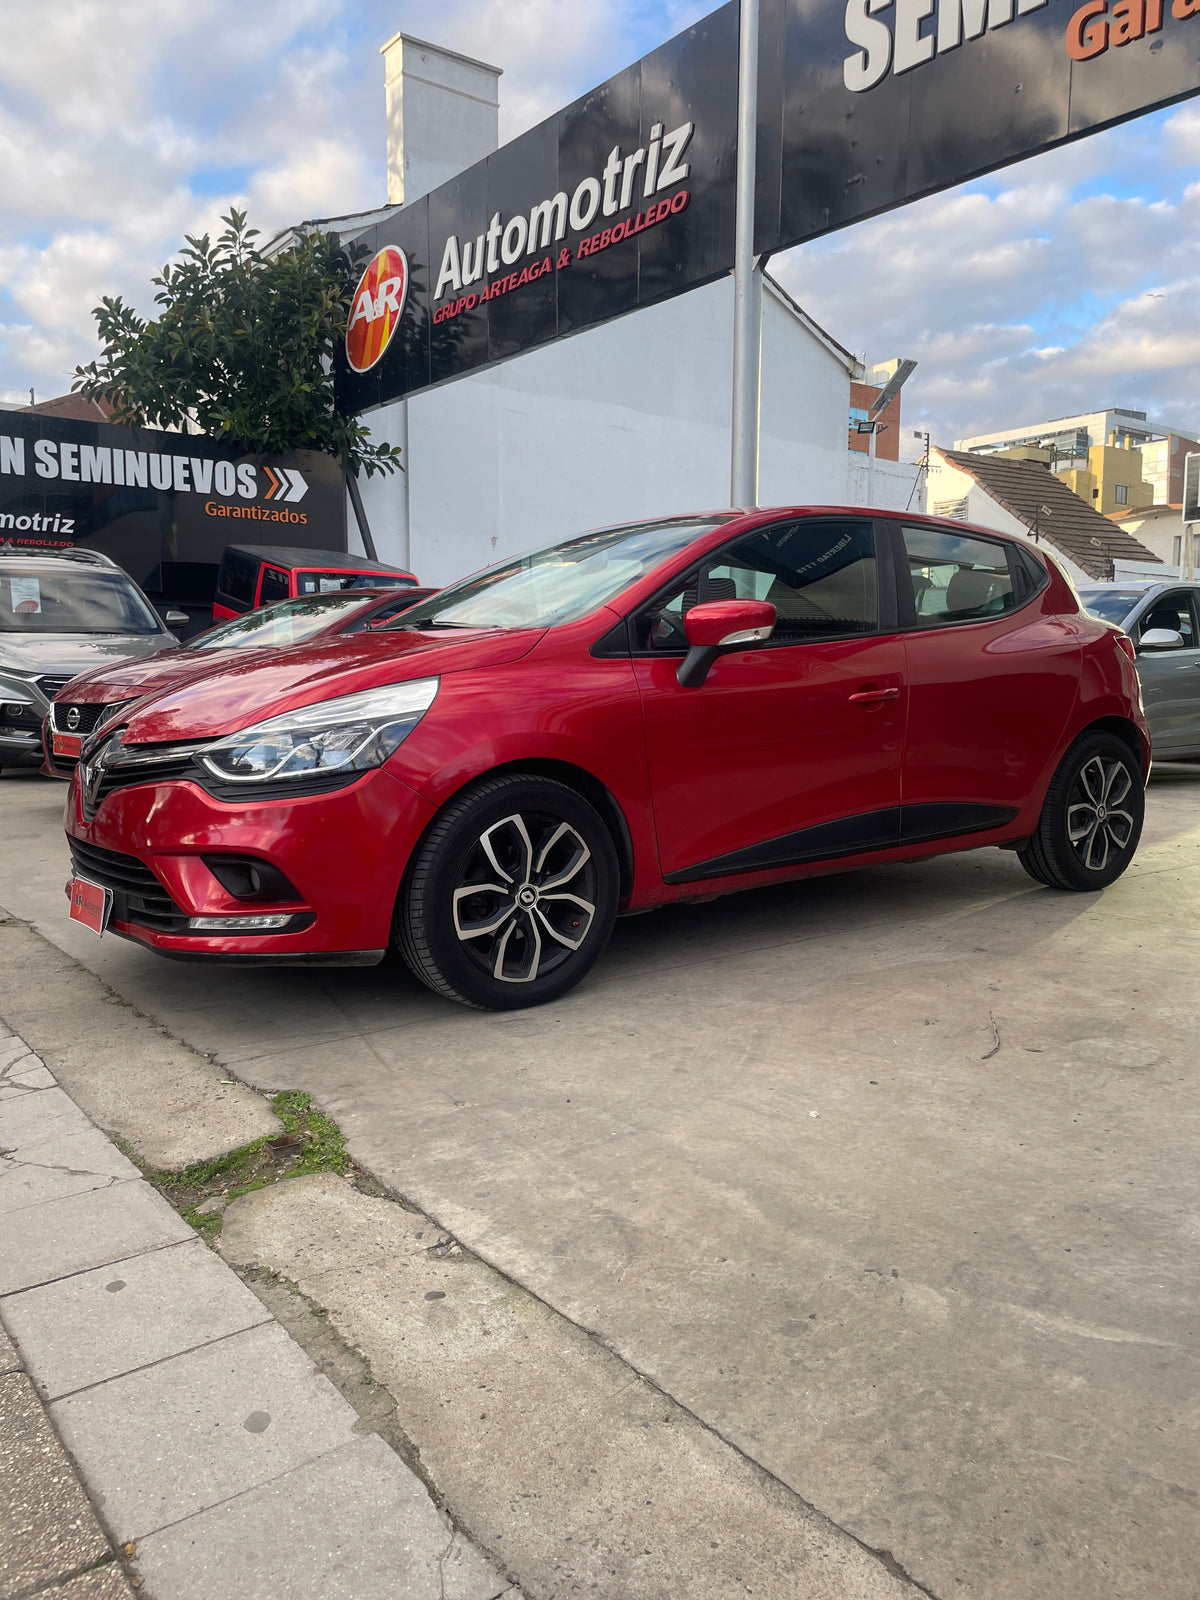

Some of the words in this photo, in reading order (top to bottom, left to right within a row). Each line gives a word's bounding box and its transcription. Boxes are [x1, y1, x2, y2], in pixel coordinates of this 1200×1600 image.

[433, 122, 695, 300] Automotriz
[433, 294, 476, 324] GRUPO
[479, 258, 551, 304] ARTEAGA
[556, 249, 571, 269] &
[578, 191, 690, 258] REBOLLEDO
[0, 436, 25, 475] N
[34, 440, 257, 498] SEMINUEVOS
[17, 538, 74, 548] REBOLLEDO
[205, 501, 307, 524] Garantizados
